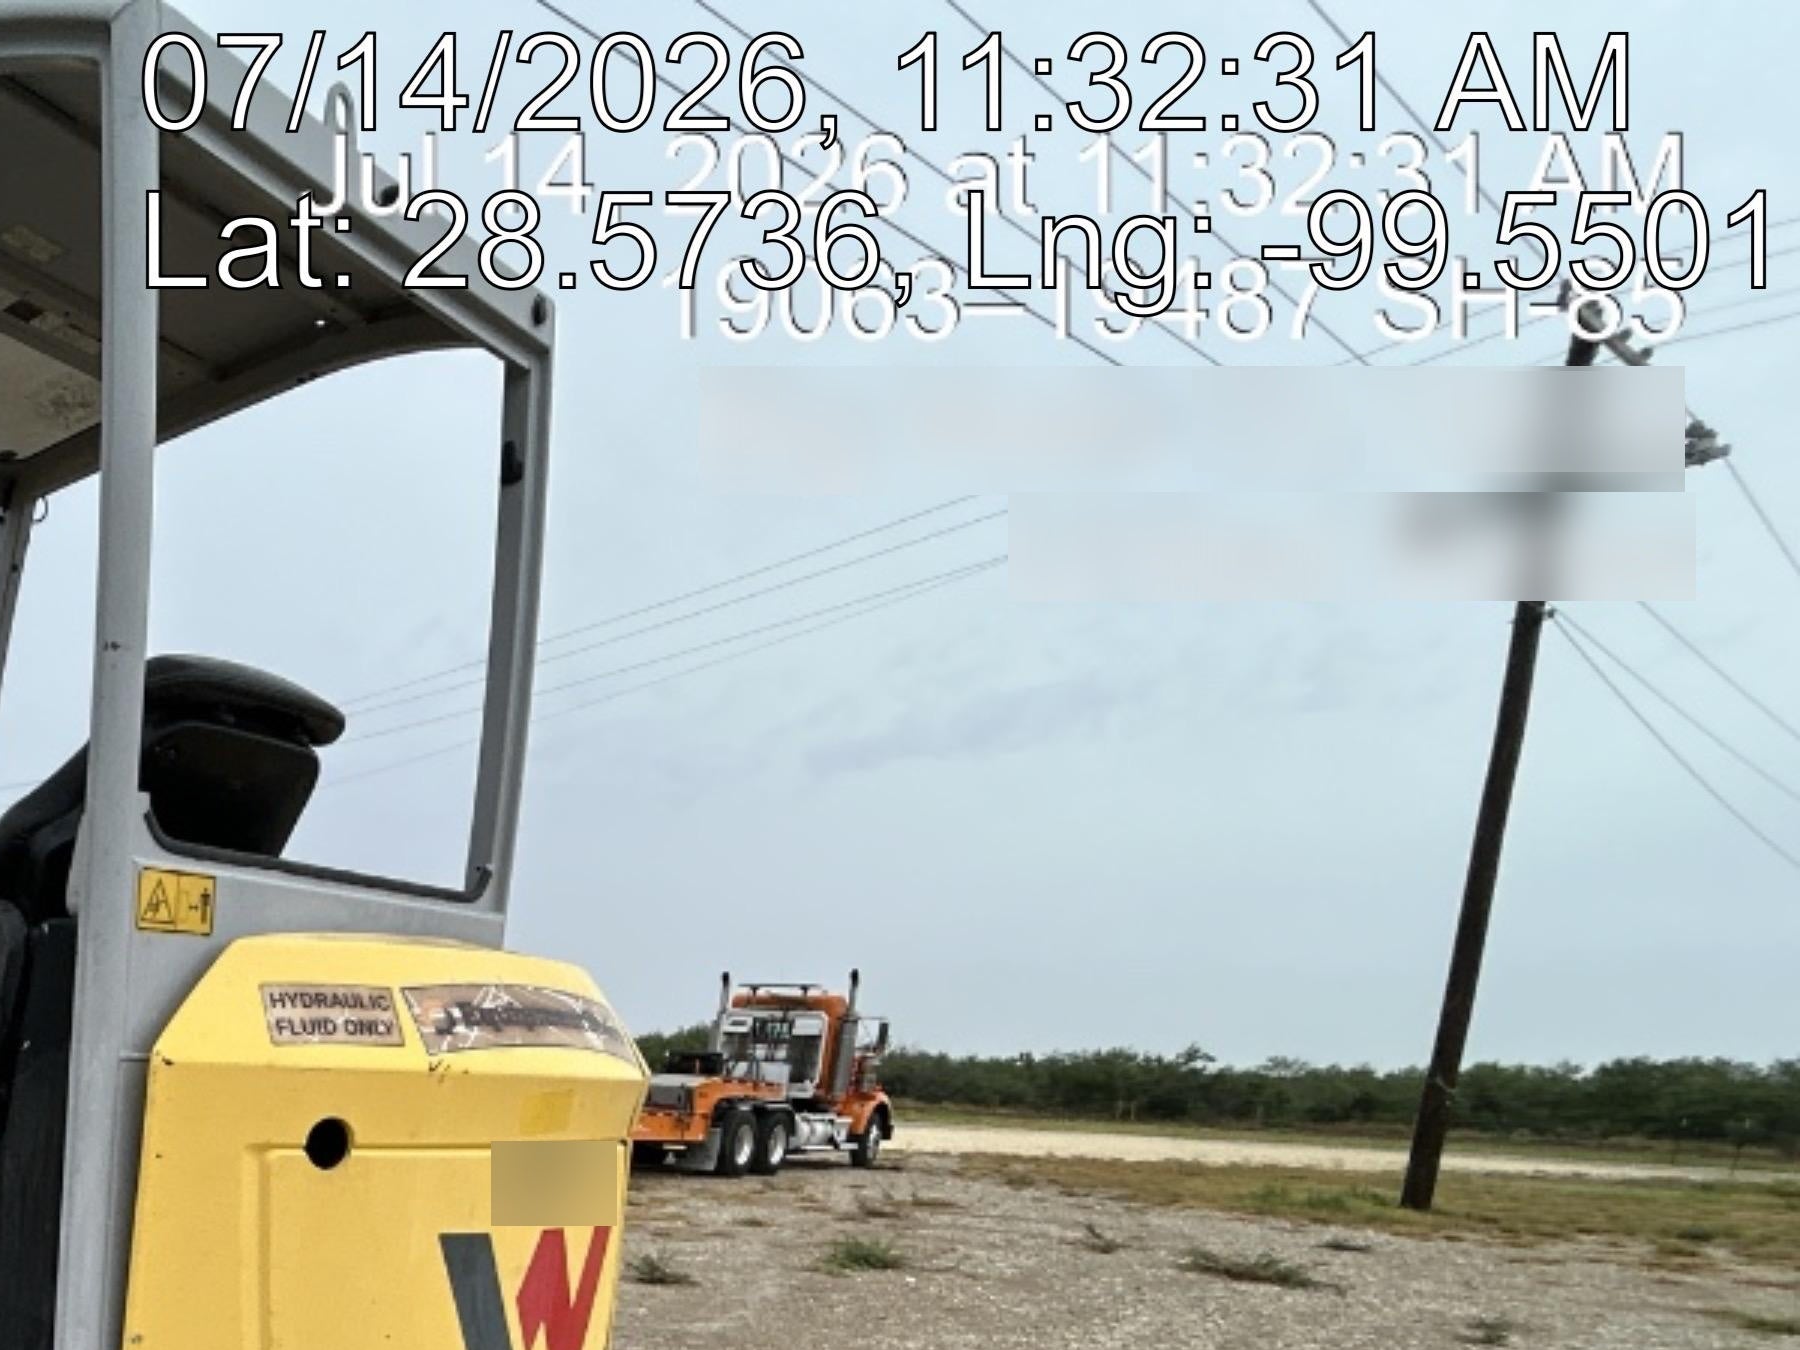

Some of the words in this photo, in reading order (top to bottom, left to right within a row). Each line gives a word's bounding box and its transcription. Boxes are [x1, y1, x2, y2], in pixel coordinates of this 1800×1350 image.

[269, 991, 390, 1011] HYDRAULIC
[276, 1017, 337, 1036] FLUID
[344, 1018, 394, 1036] ONLY
